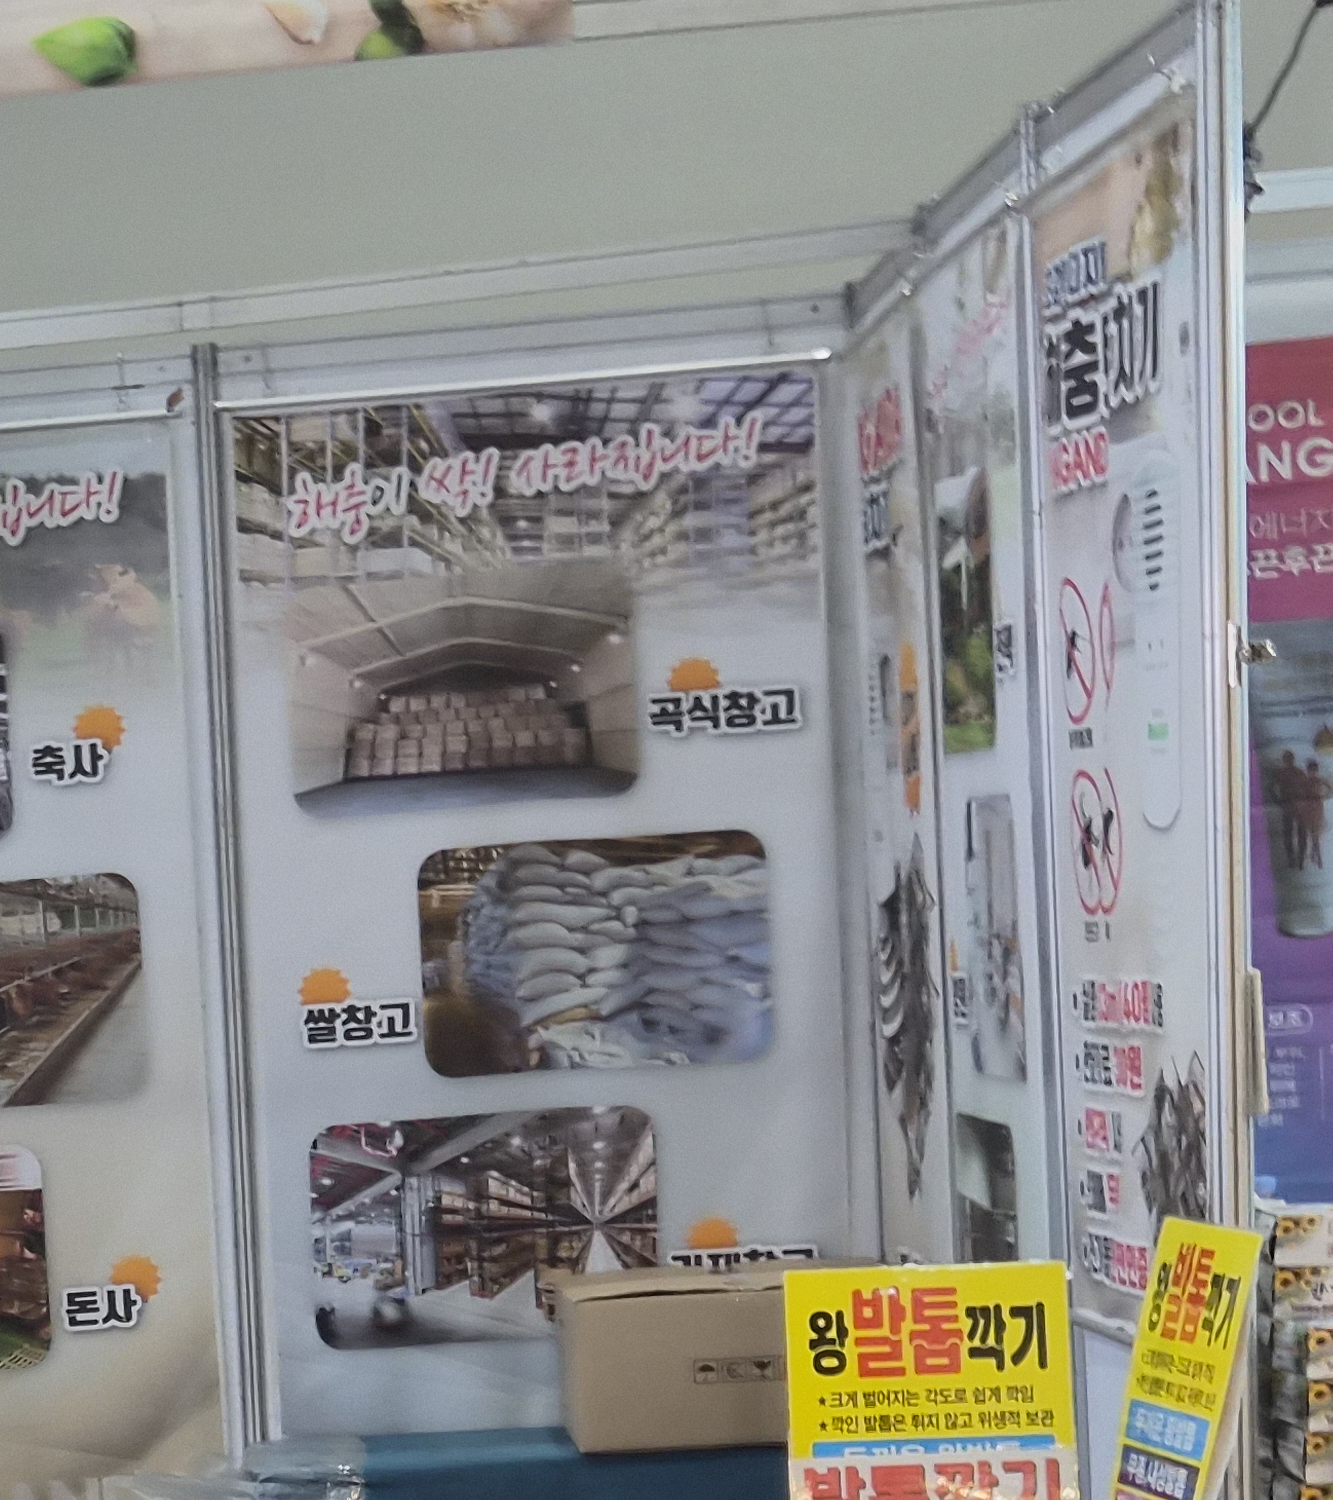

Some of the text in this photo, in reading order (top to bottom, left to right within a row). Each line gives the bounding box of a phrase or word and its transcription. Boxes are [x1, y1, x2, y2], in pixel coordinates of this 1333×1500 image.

[1246, 437, 1333, 484] NG
[650, 691, 796, 728] 곡식창고
[33, 743, 102, 779] 축사
[304, 1003, 414, 1044] 쌀창고
[64, 1287, 139, 1327] 돈사
